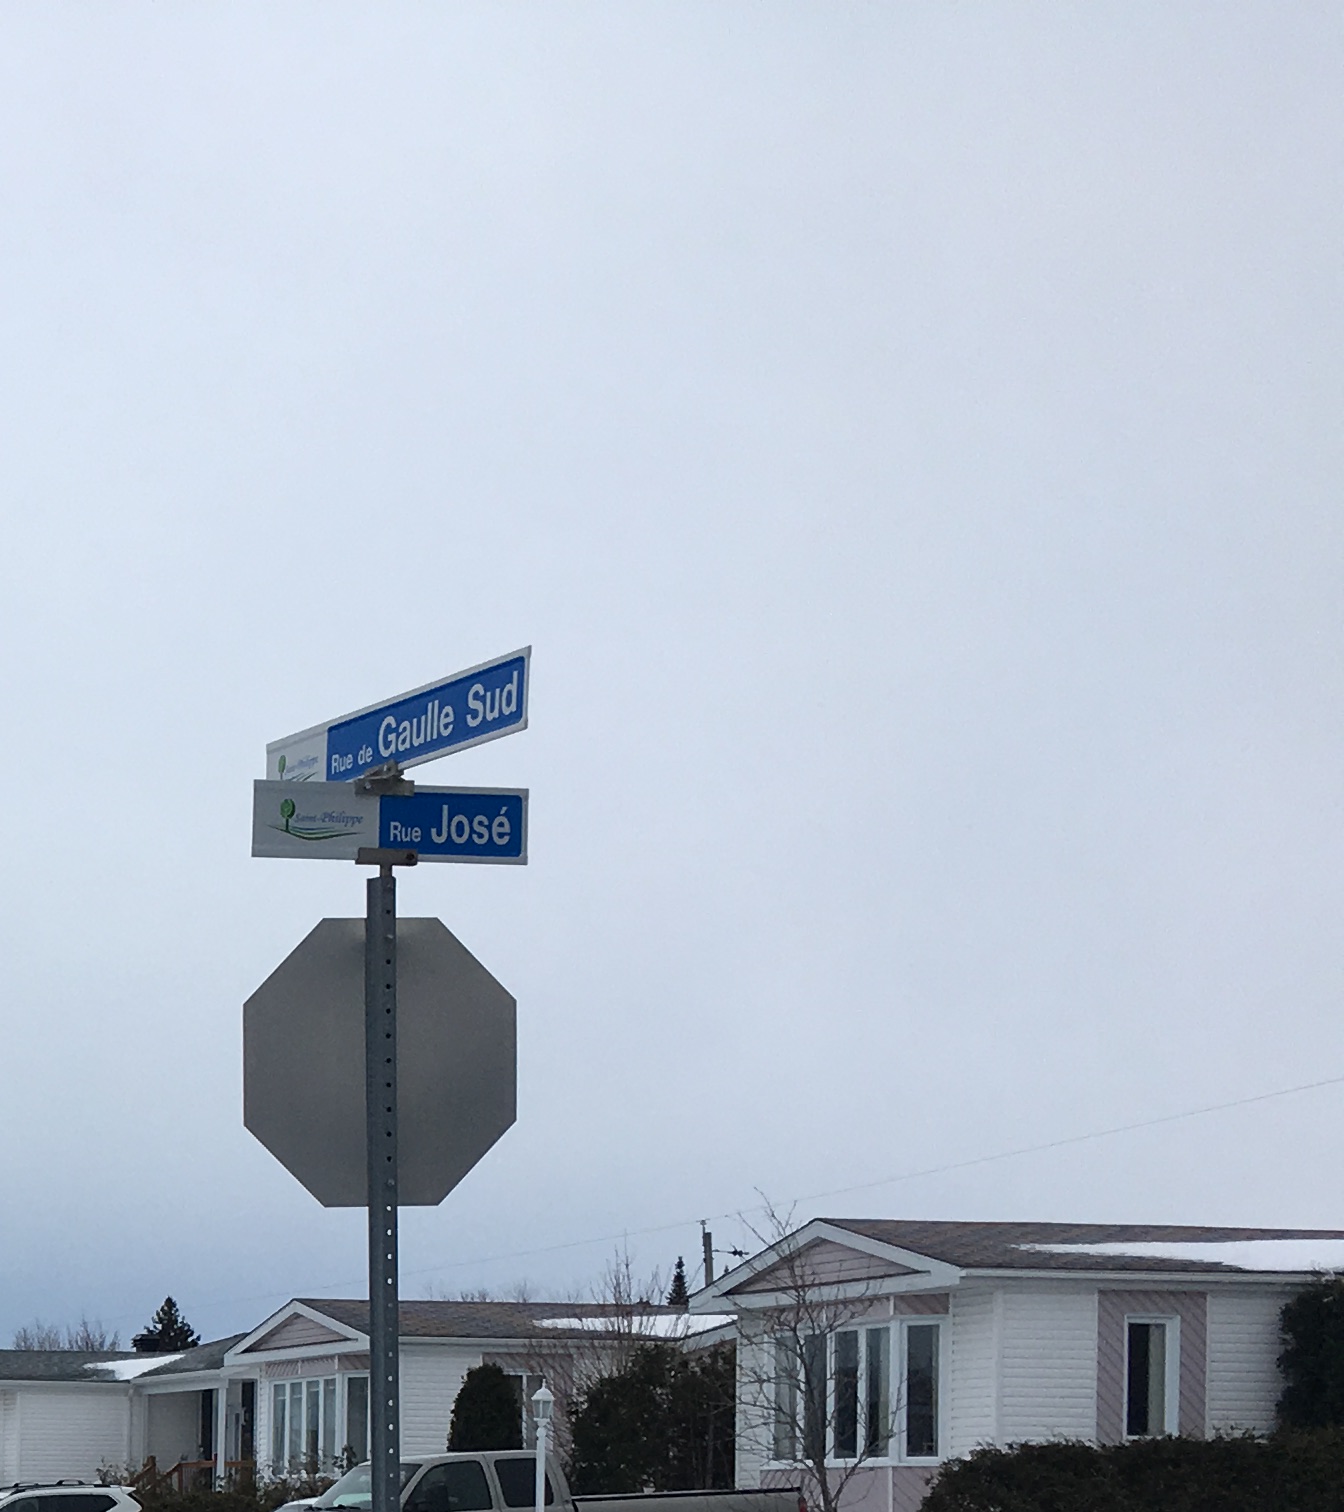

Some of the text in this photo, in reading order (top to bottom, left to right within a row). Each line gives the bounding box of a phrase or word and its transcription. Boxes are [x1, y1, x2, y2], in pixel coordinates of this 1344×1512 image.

[331, 752, 353, 775] Rue
[358, 744, 373, 765] de
[378, 699, 455, 758] Gaulle
[466, 671, 519, 728] Sud
[390, 804, 511, 846] Rue José
